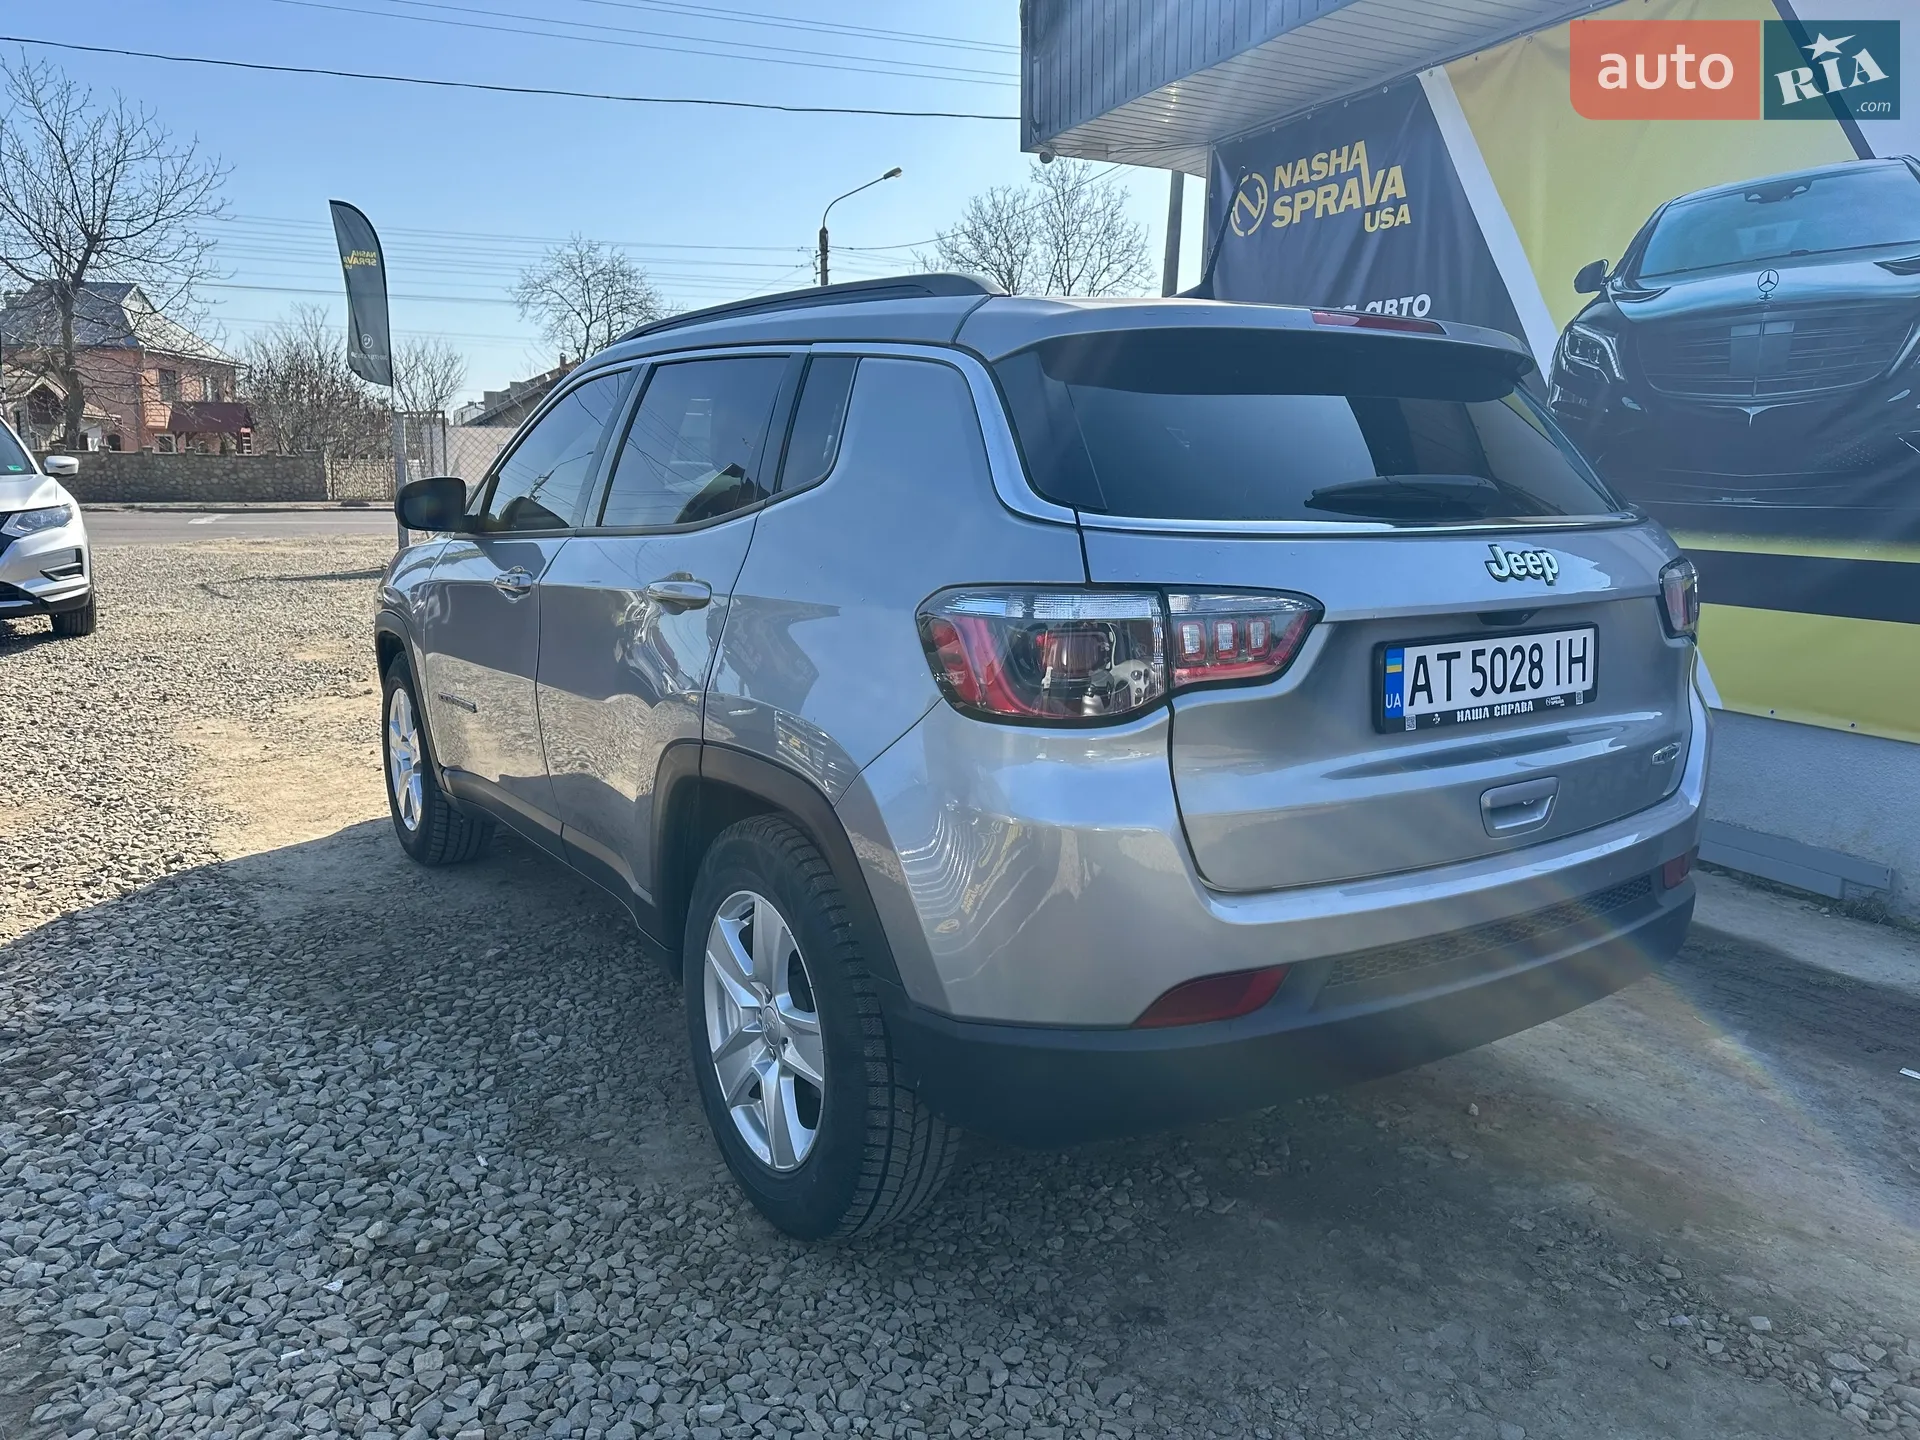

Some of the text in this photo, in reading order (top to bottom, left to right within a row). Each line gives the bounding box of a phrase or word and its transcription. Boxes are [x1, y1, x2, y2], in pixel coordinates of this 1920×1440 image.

[1273, 140, 1366, 192] NASHA
[1271, 164, 1407, 229] SPRAVA
[1364, 203, 1412, 233] USA
[1484, 543, 1560, 587] Jeep
[1408, 636, 1588, 707] AT 5028 IH
[1385, 693, 1402, 709] UA
[1456, 706, 1490, 723] НАША
[1493, 700, 1534, 717] СПРАВА
